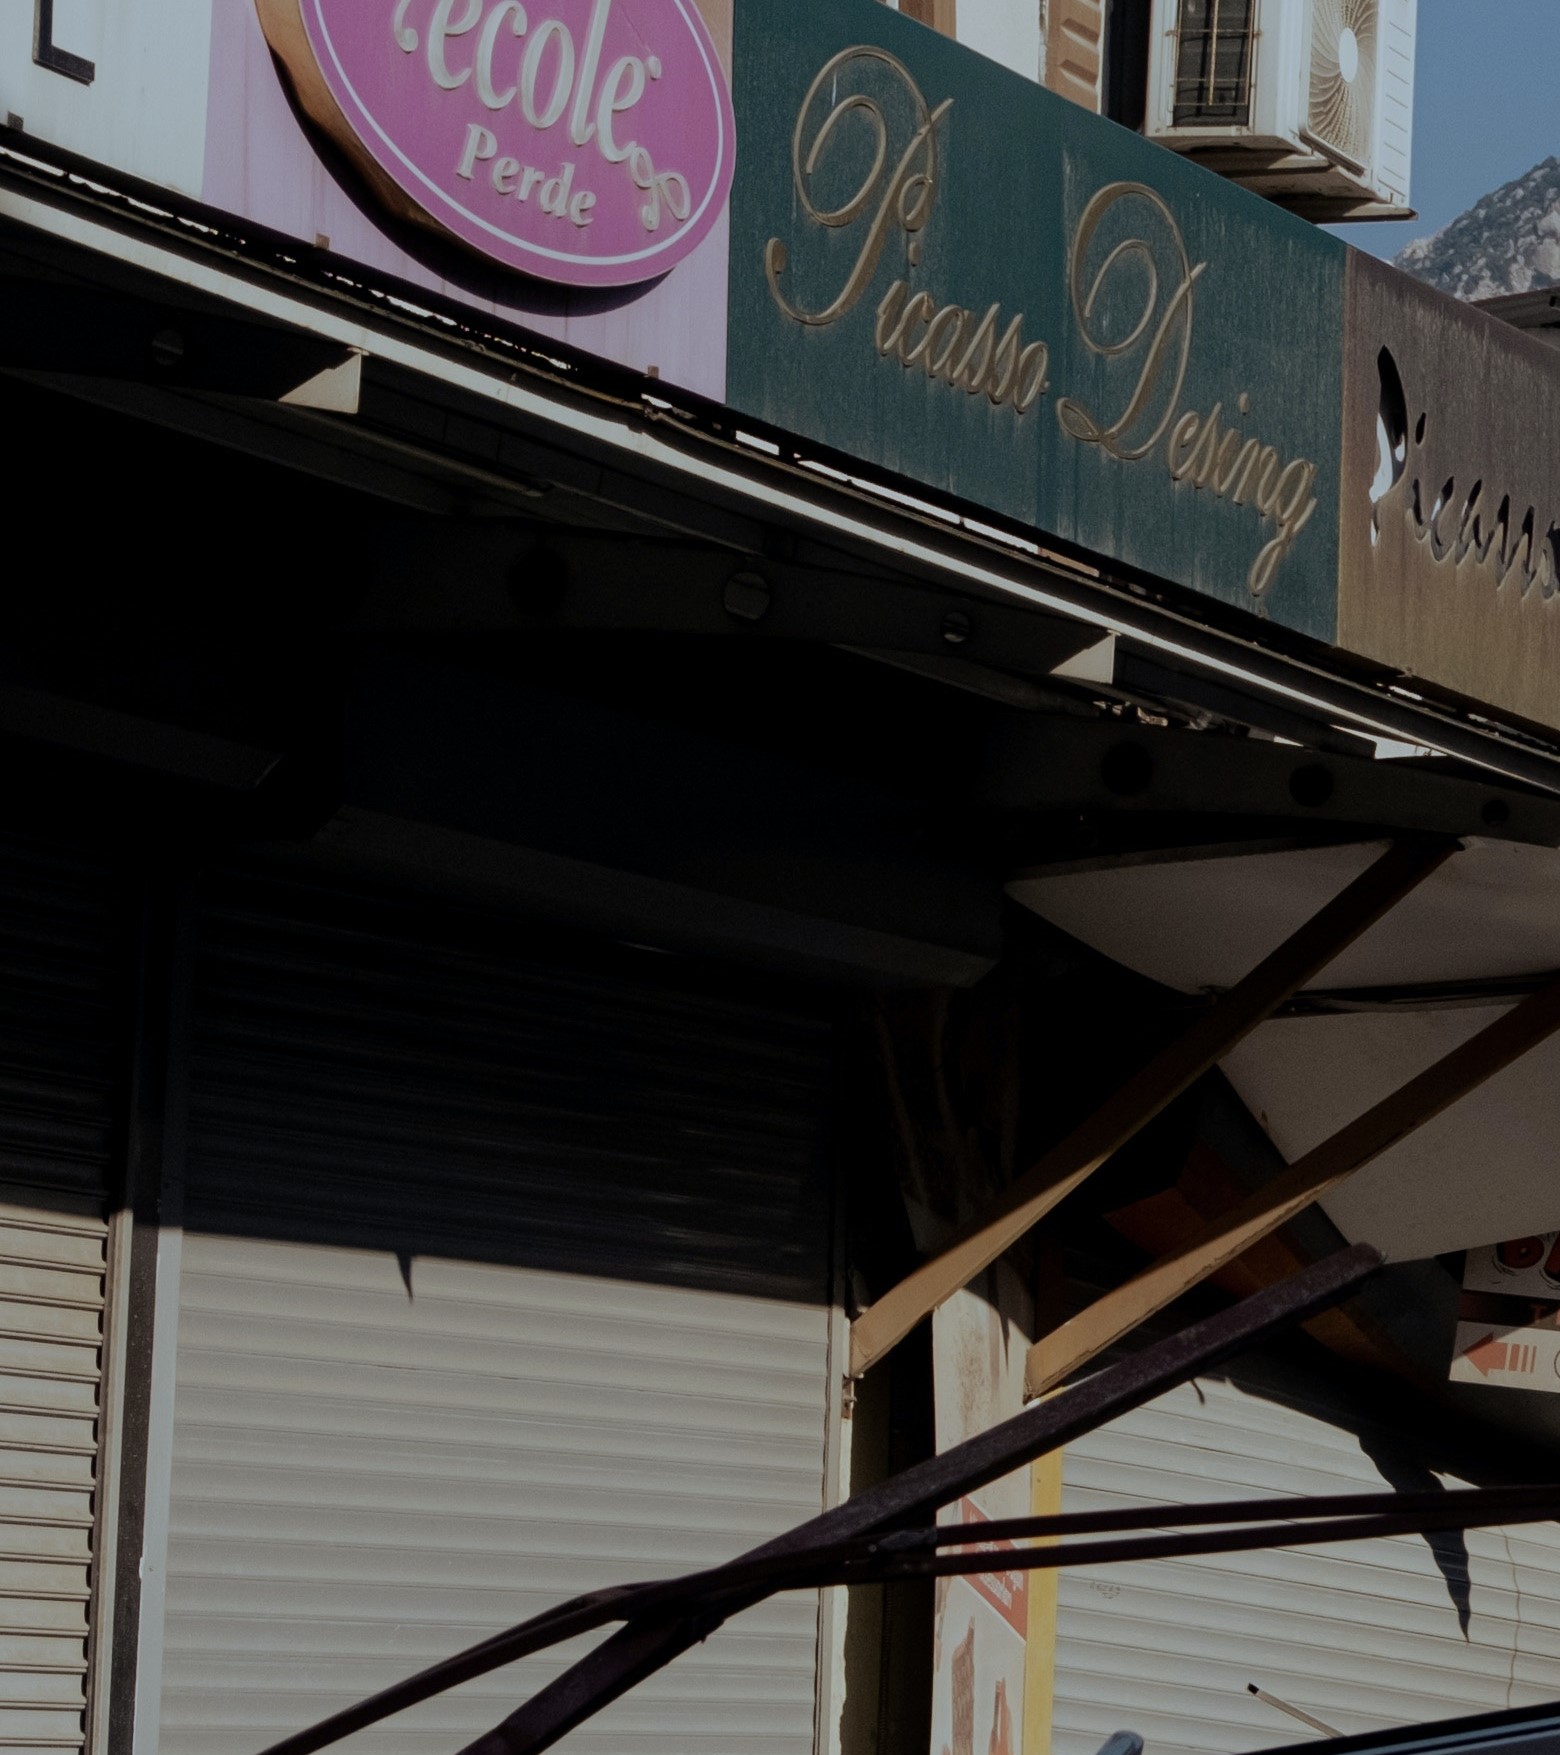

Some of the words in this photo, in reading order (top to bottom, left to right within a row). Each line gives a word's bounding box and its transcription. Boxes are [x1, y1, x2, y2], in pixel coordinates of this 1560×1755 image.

[456, 123, 597, 227] Perde
[765, 44, 1050, 415] Picasso
[1056, 180, 1318, 597] Desing
